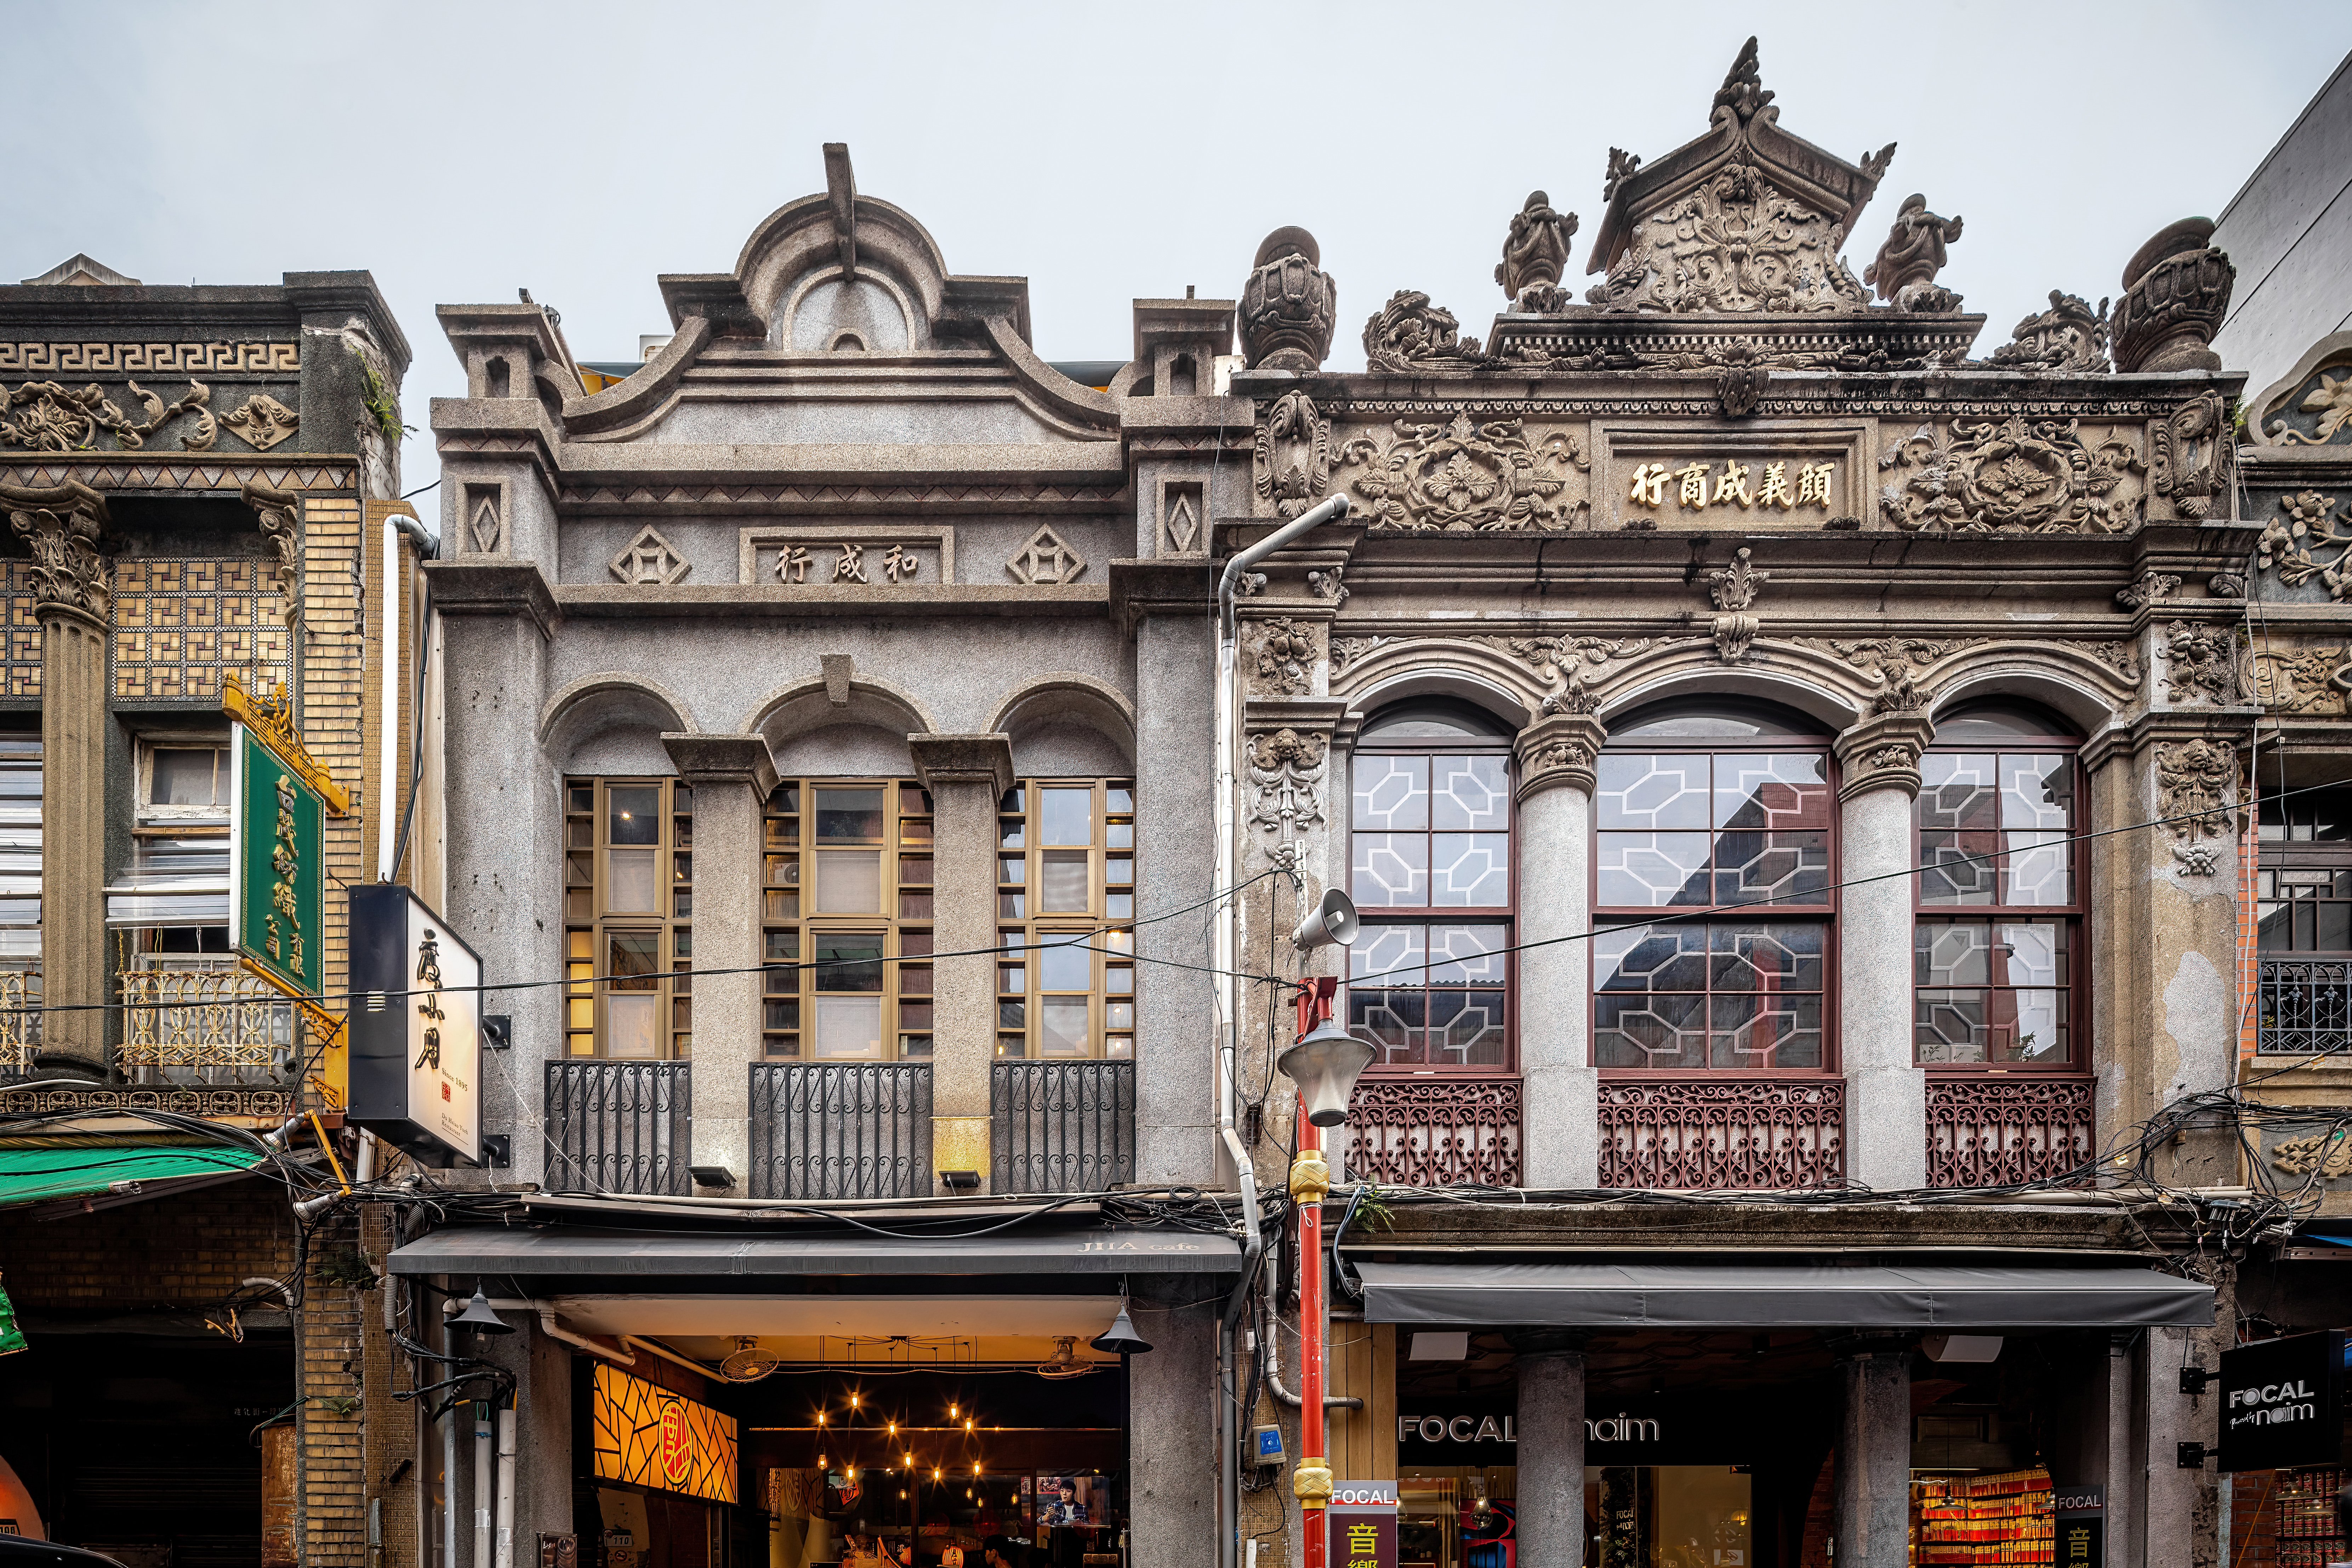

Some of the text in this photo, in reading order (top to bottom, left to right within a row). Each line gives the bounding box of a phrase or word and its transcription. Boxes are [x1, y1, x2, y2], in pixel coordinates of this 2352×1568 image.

[442, 1067, 467, 1091] Since 1895
[2229, 1380, 2314, 1408] FOCAL
[2256, 1402, 2314, 1425] naim
[1399, 1415, 1516, 1441] FOCAL
[1331, 1489, 1394, 1504] FOCAL
[2059, 1495, 2101, 1509] FOCAL
[614, 1536, 629, 1545] 110
[1347, 1523, 1378, 1568] 音
[2068, 1527, 2090, 1568] 音
